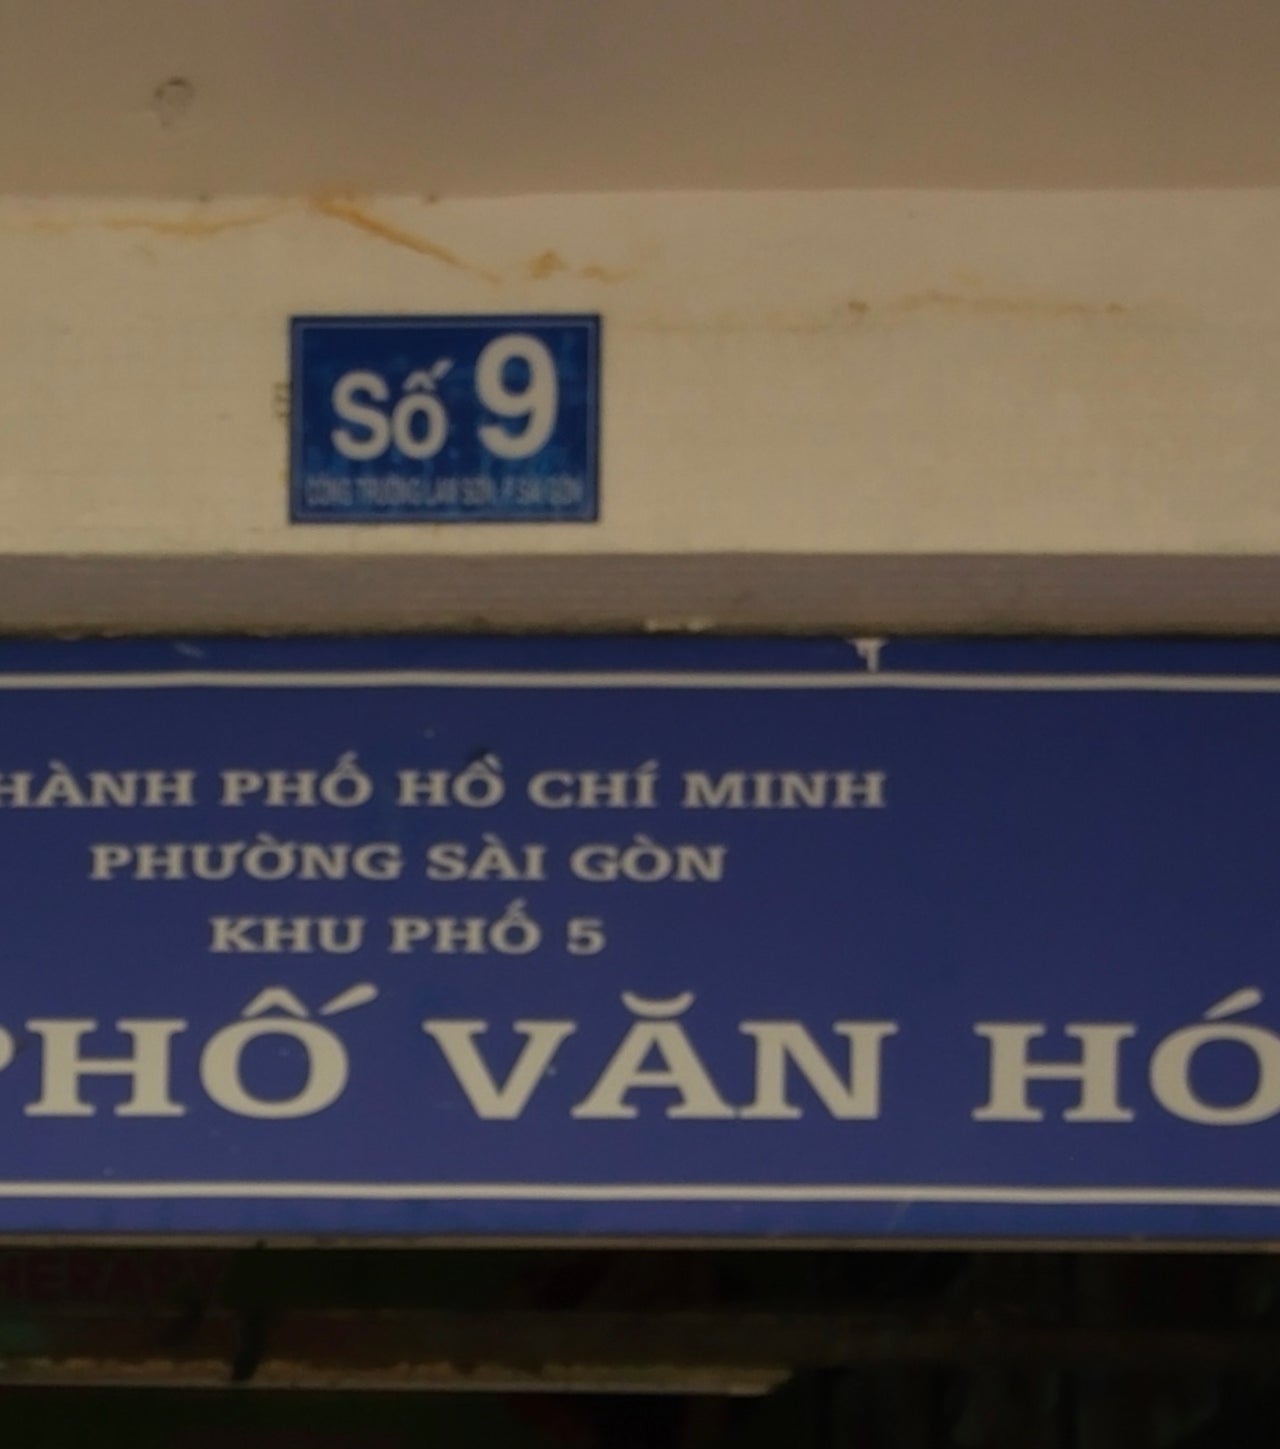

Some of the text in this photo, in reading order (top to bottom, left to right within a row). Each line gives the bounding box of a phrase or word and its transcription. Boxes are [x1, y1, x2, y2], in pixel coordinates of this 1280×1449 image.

[331, 333, 559, 461] Số 9
[220, 751, 373, 808] PHỐ
[397, 754, 506, 809] HỒ
[527, 759, 660, 810] CHÍ
[683, 771, 886, 810] MINH
[89, 832, 727, 883] PHƯỜNG SÀI GÒN
[209, 898, 606, 956] KHU PHỐ 5
[422, 991, 898, 1121] VĂN
